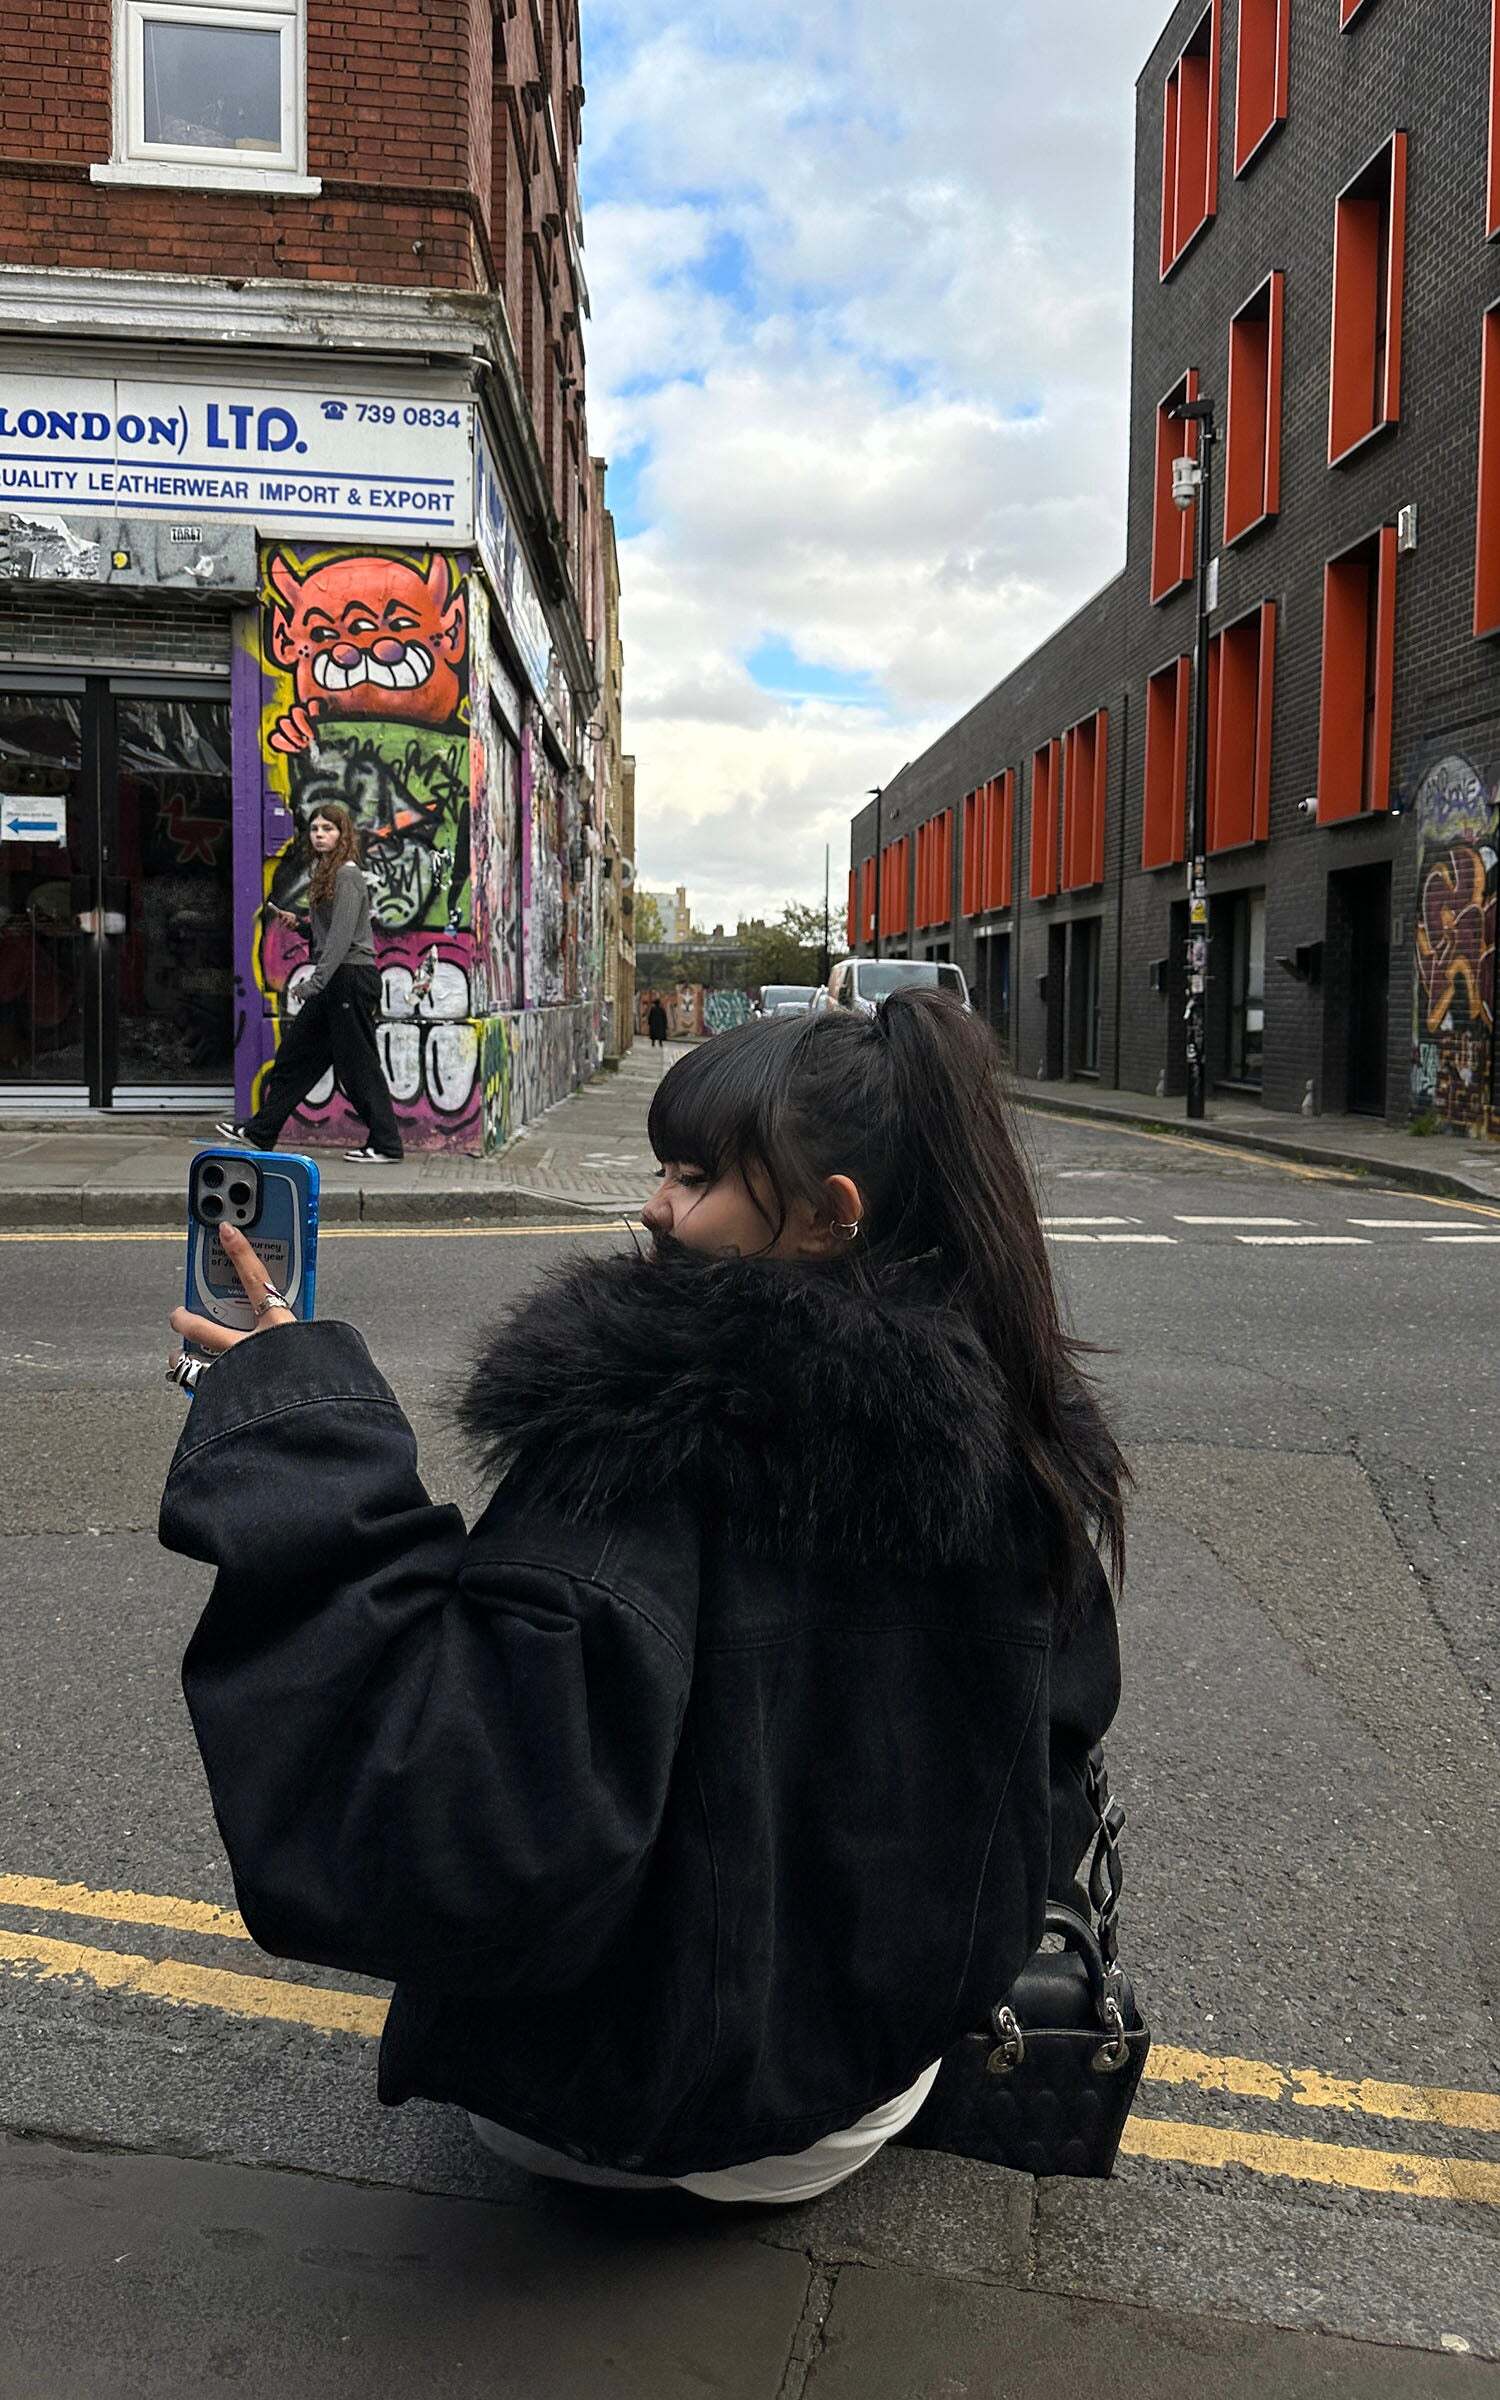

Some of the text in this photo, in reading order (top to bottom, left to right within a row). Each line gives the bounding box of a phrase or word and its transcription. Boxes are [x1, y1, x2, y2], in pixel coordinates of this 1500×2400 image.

[206, 403, 308, 454] LTD.
[355, 403, 461, 428] 739 0834
[0, 468, 455, 511] UALITY LEATHERWEAR IMPORT & EXPORT
